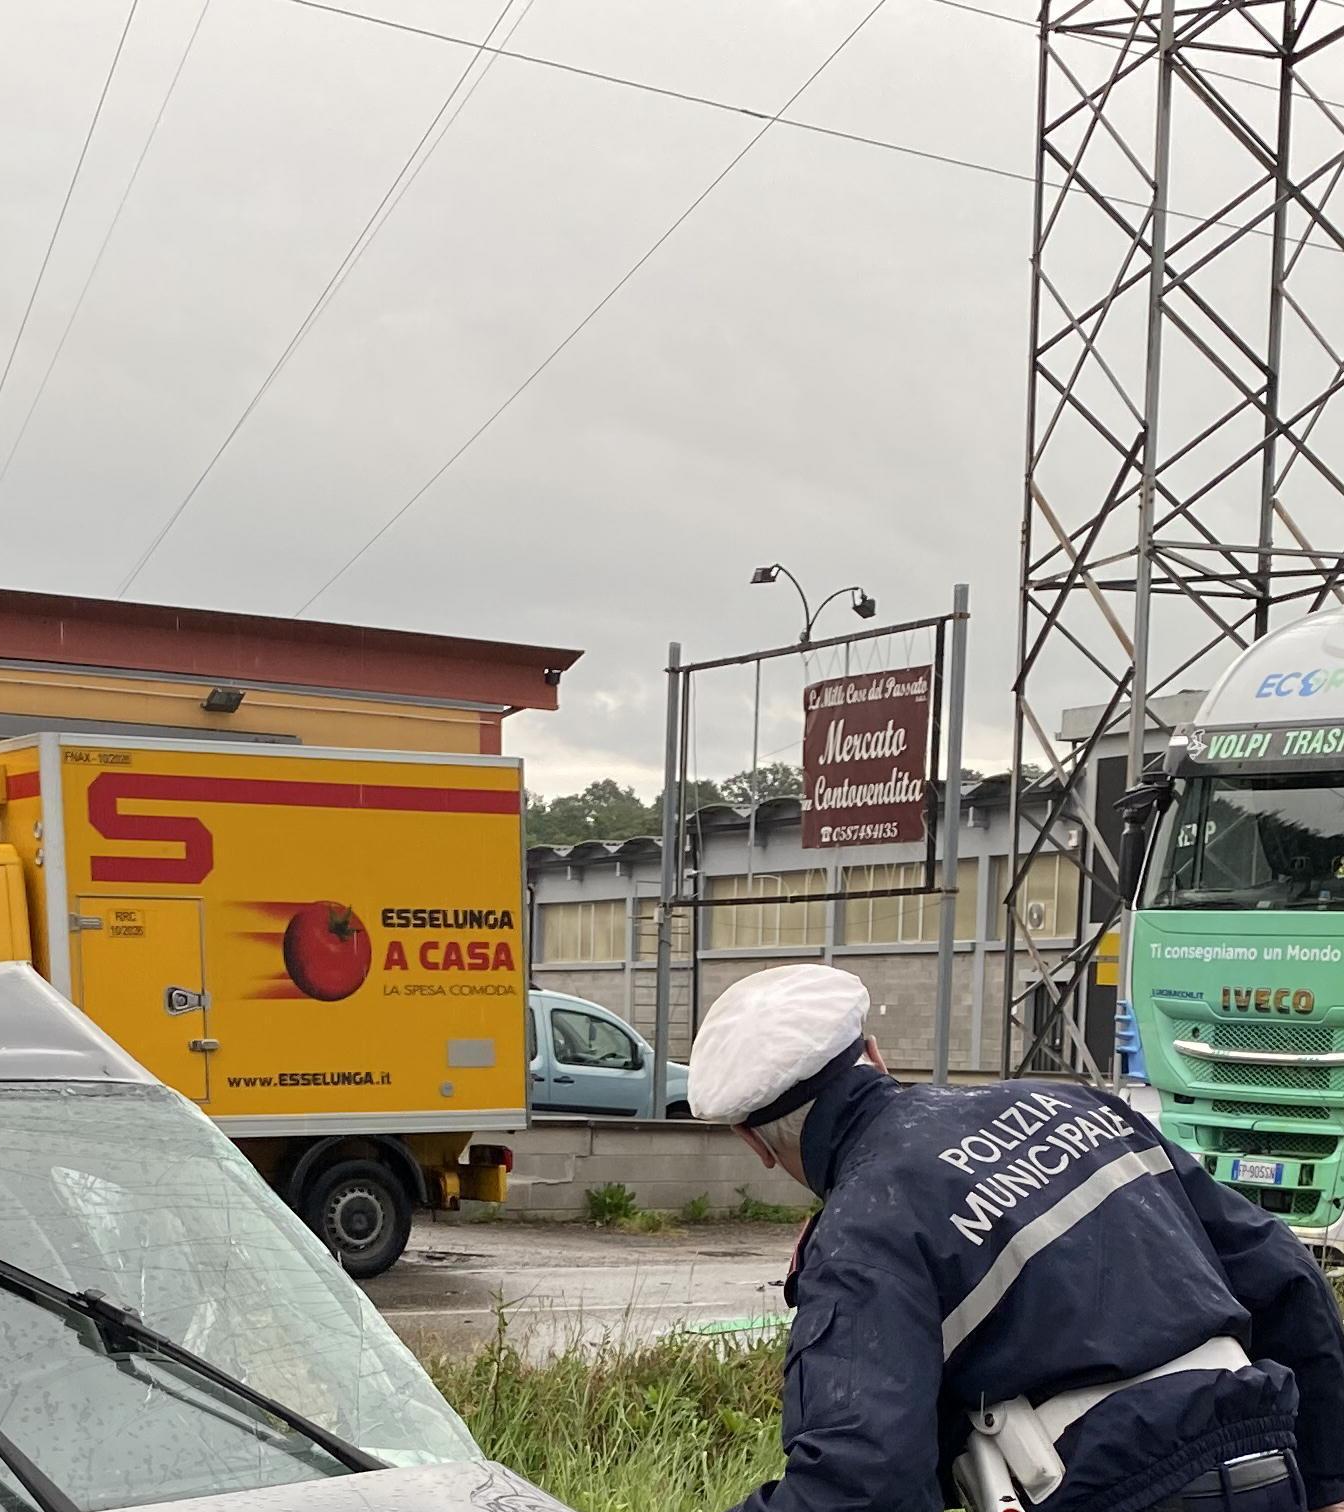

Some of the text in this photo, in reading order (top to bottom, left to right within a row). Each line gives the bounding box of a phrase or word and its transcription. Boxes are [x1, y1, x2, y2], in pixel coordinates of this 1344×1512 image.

[884, 676, 928, 699] Passato
[818, 718, 907, 765] Mercato
[1207, 733, 1272, 760] VOLPI
[815, 767, 924, 811] Contovendita
[381, 908, 515, 930] ESSELUNGA
[383, 940, 516, 971] A CASA
[1149, 943, 1162, 959] Ti
[1164, 943, 1257, 962] consegniamo
[1263, 948, 1283, 961] un
[1286, 944, 1341, 962] Mondo
[383, 984, 517, 997] LA SPESA COMODA
[1221, 985, 1316, 1015] IVECO
[227, 1071, 392, 1088] www.ESSELUNGA.it
[937, 1092, 1072, 1176] POLIZIA
